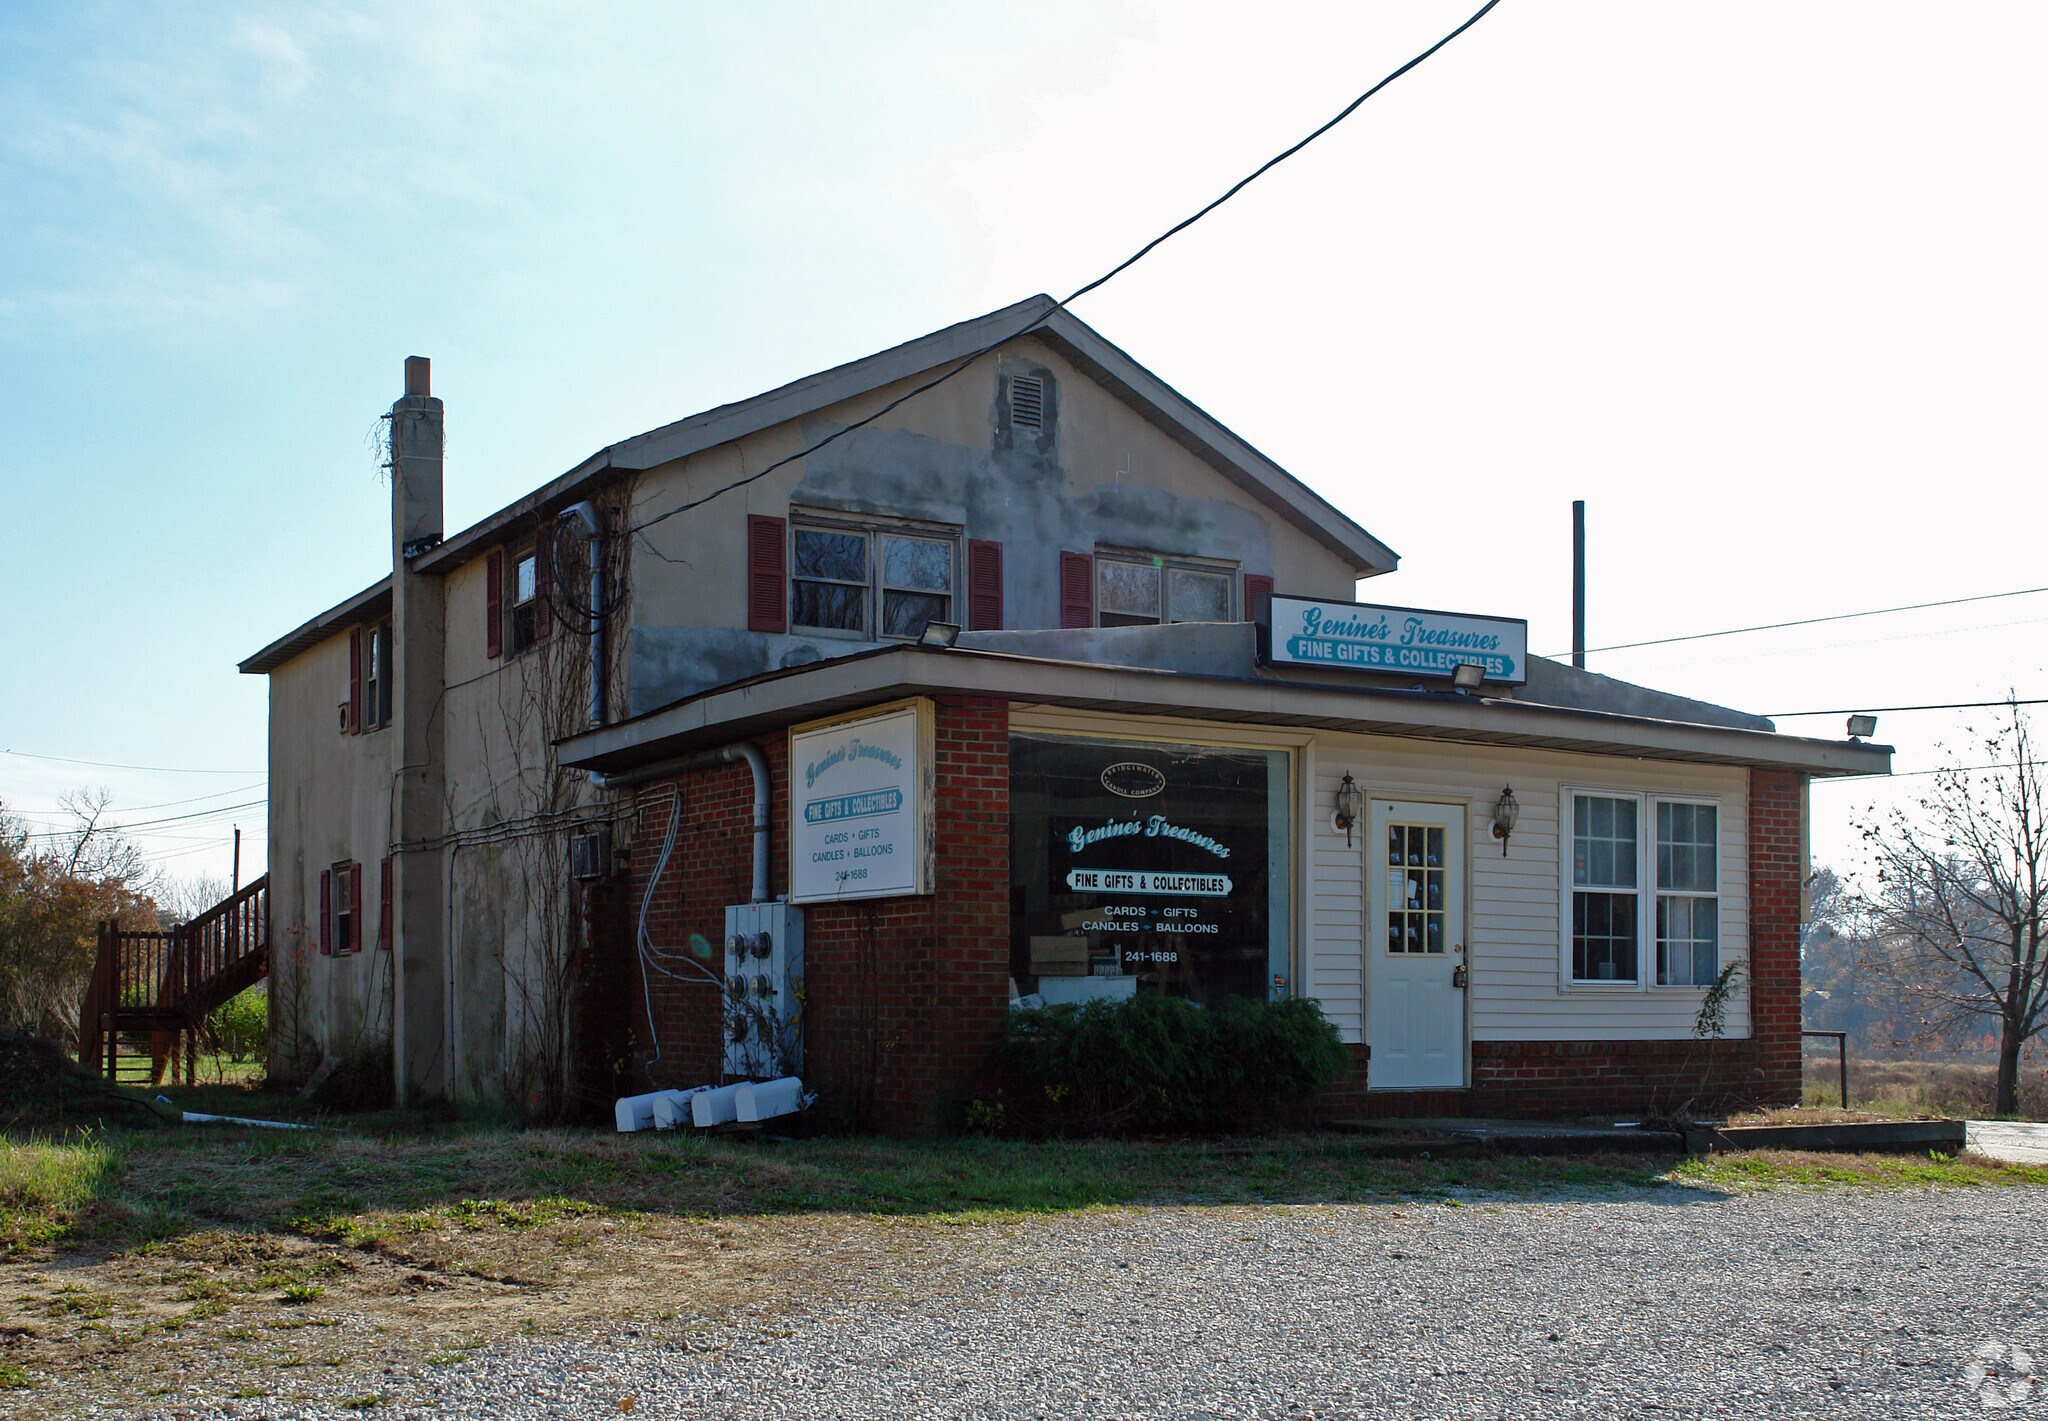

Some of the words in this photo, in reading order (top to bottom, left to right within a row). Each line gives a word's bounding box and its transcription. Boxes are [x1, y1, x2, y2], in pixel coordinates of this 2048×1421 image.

[1302, 607, 1391, 640] Genine's
[1400, 617, 1501, 651] Treasures
[1298, 640, 1333, 658] FINE
[1337, 644, 1380, 663] GIFTS
[1384, 649, 1395, 664] &
[805, 744, 848, 789] Genine's
[848, 738, 903, 770] Treasures
[1130, 785, 1160, 795] COMPANY
[808, 804, 822, 821] FINE
[824, 801, 842, 818] GIFTS
[844, 800, 850, 815] &
[852, 792, 897, 814] COLLECTIBLES
[824, 832, 848, 845] CARDS
[858, 828, 880, 841] GIFTS
[1065, 809, 1143, 852] Genine's
[1144, 814, 1230, 859] Treasures
[812, 850, 844, 863] CANDLES
[853, 844, 893, 858] BALLOONS
[1075, 873, 1098, 888] FINE
[1104, 874, 1134, 889] GIFTS
[1139, 875, 1147, 890] &
[1153, 876, 1224, 892] COLLECTIBLES
[1104, 905, 1147, 917] CARDS
[1163, 907, 1198, 918] GIFTS
[1082, 920, 1139, 932] CANDLES
[1155, 922, 1219, 934] BALLOONS
[1125, 951, 1178, 963] 241-1688
